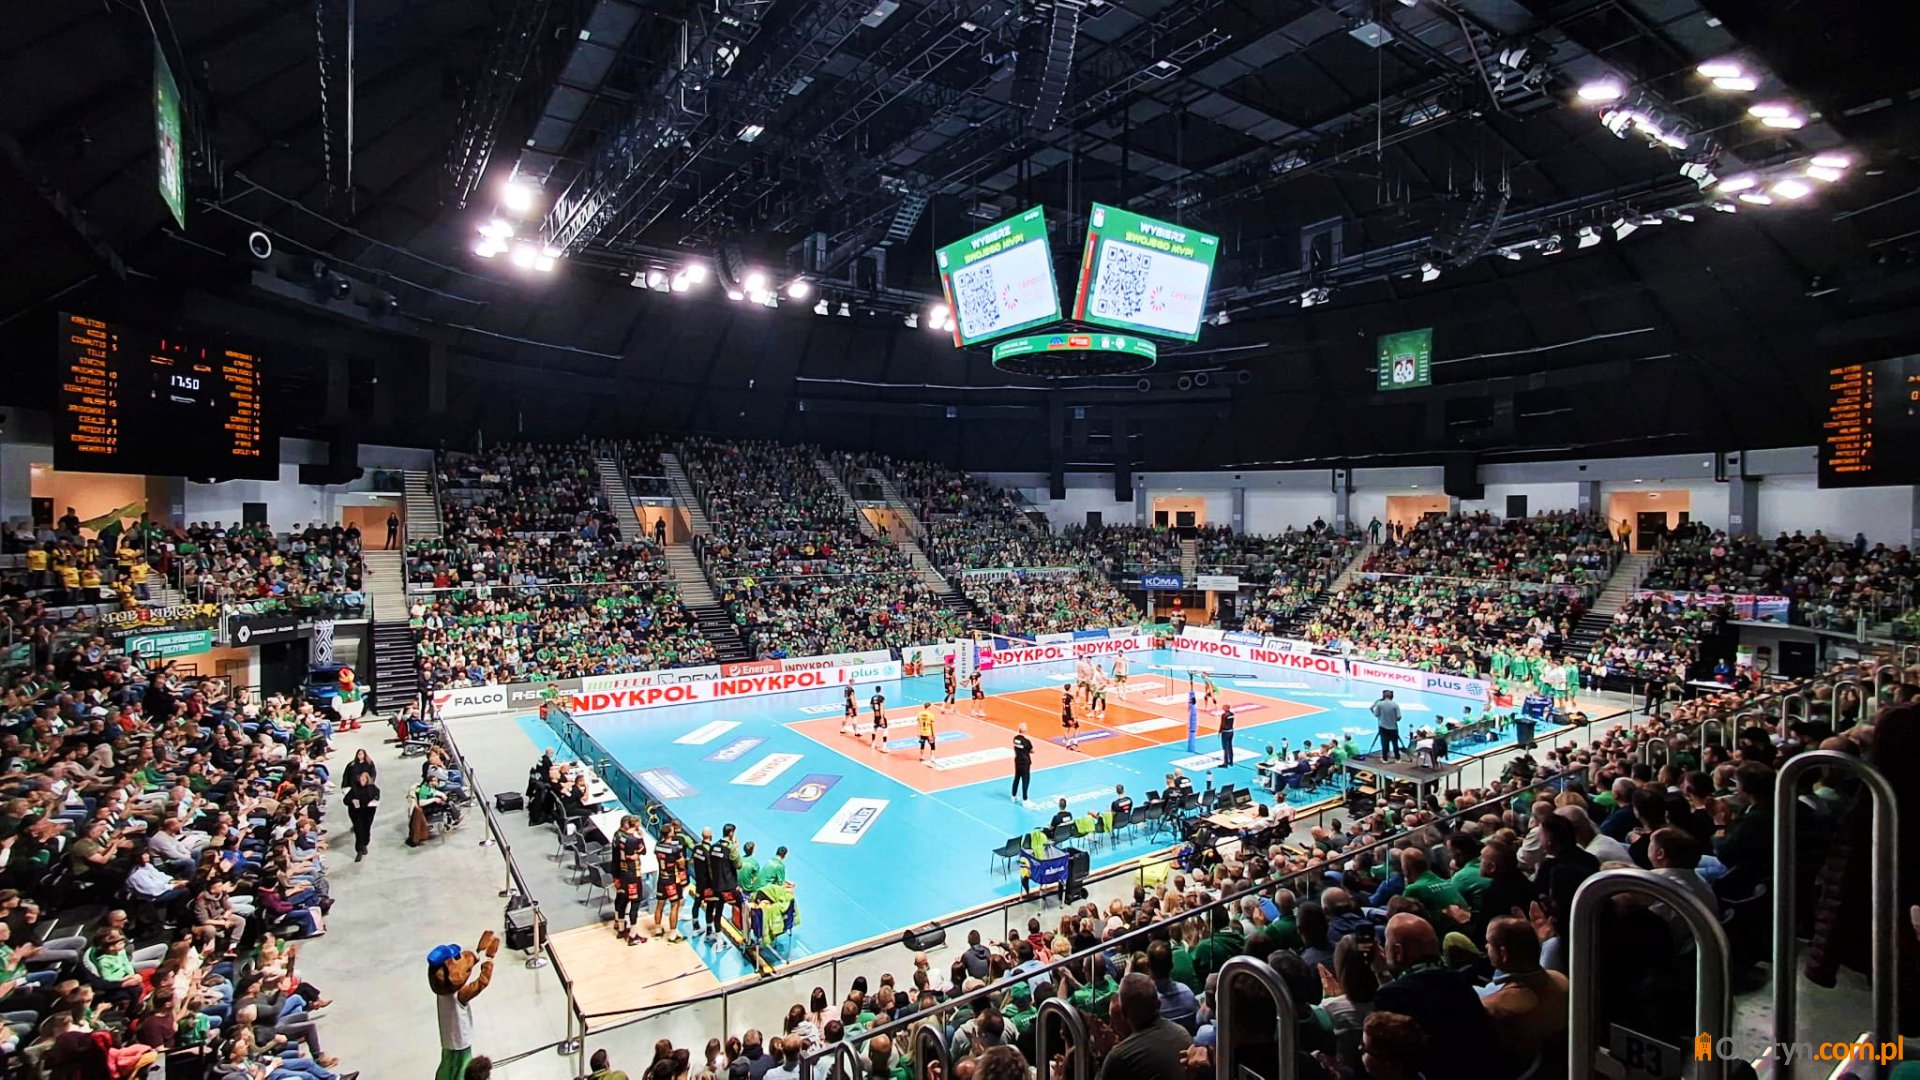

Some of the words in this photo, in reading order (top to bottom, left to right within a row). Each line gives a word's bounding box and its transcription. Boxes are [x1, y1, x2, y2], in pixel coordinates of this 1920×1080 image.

[1251, 648, 1340, 674] INDYKPOL
[742, 665, 774, 674] Energa
[851, 667, 879, 679] plus
[1364, 669, 1417, 684] INDYKPOL
[712, 671, 826, 697] INDYKPOL
[1427, 678, 1461, 691] plus
[454, 693, 503, 706] FALCO
